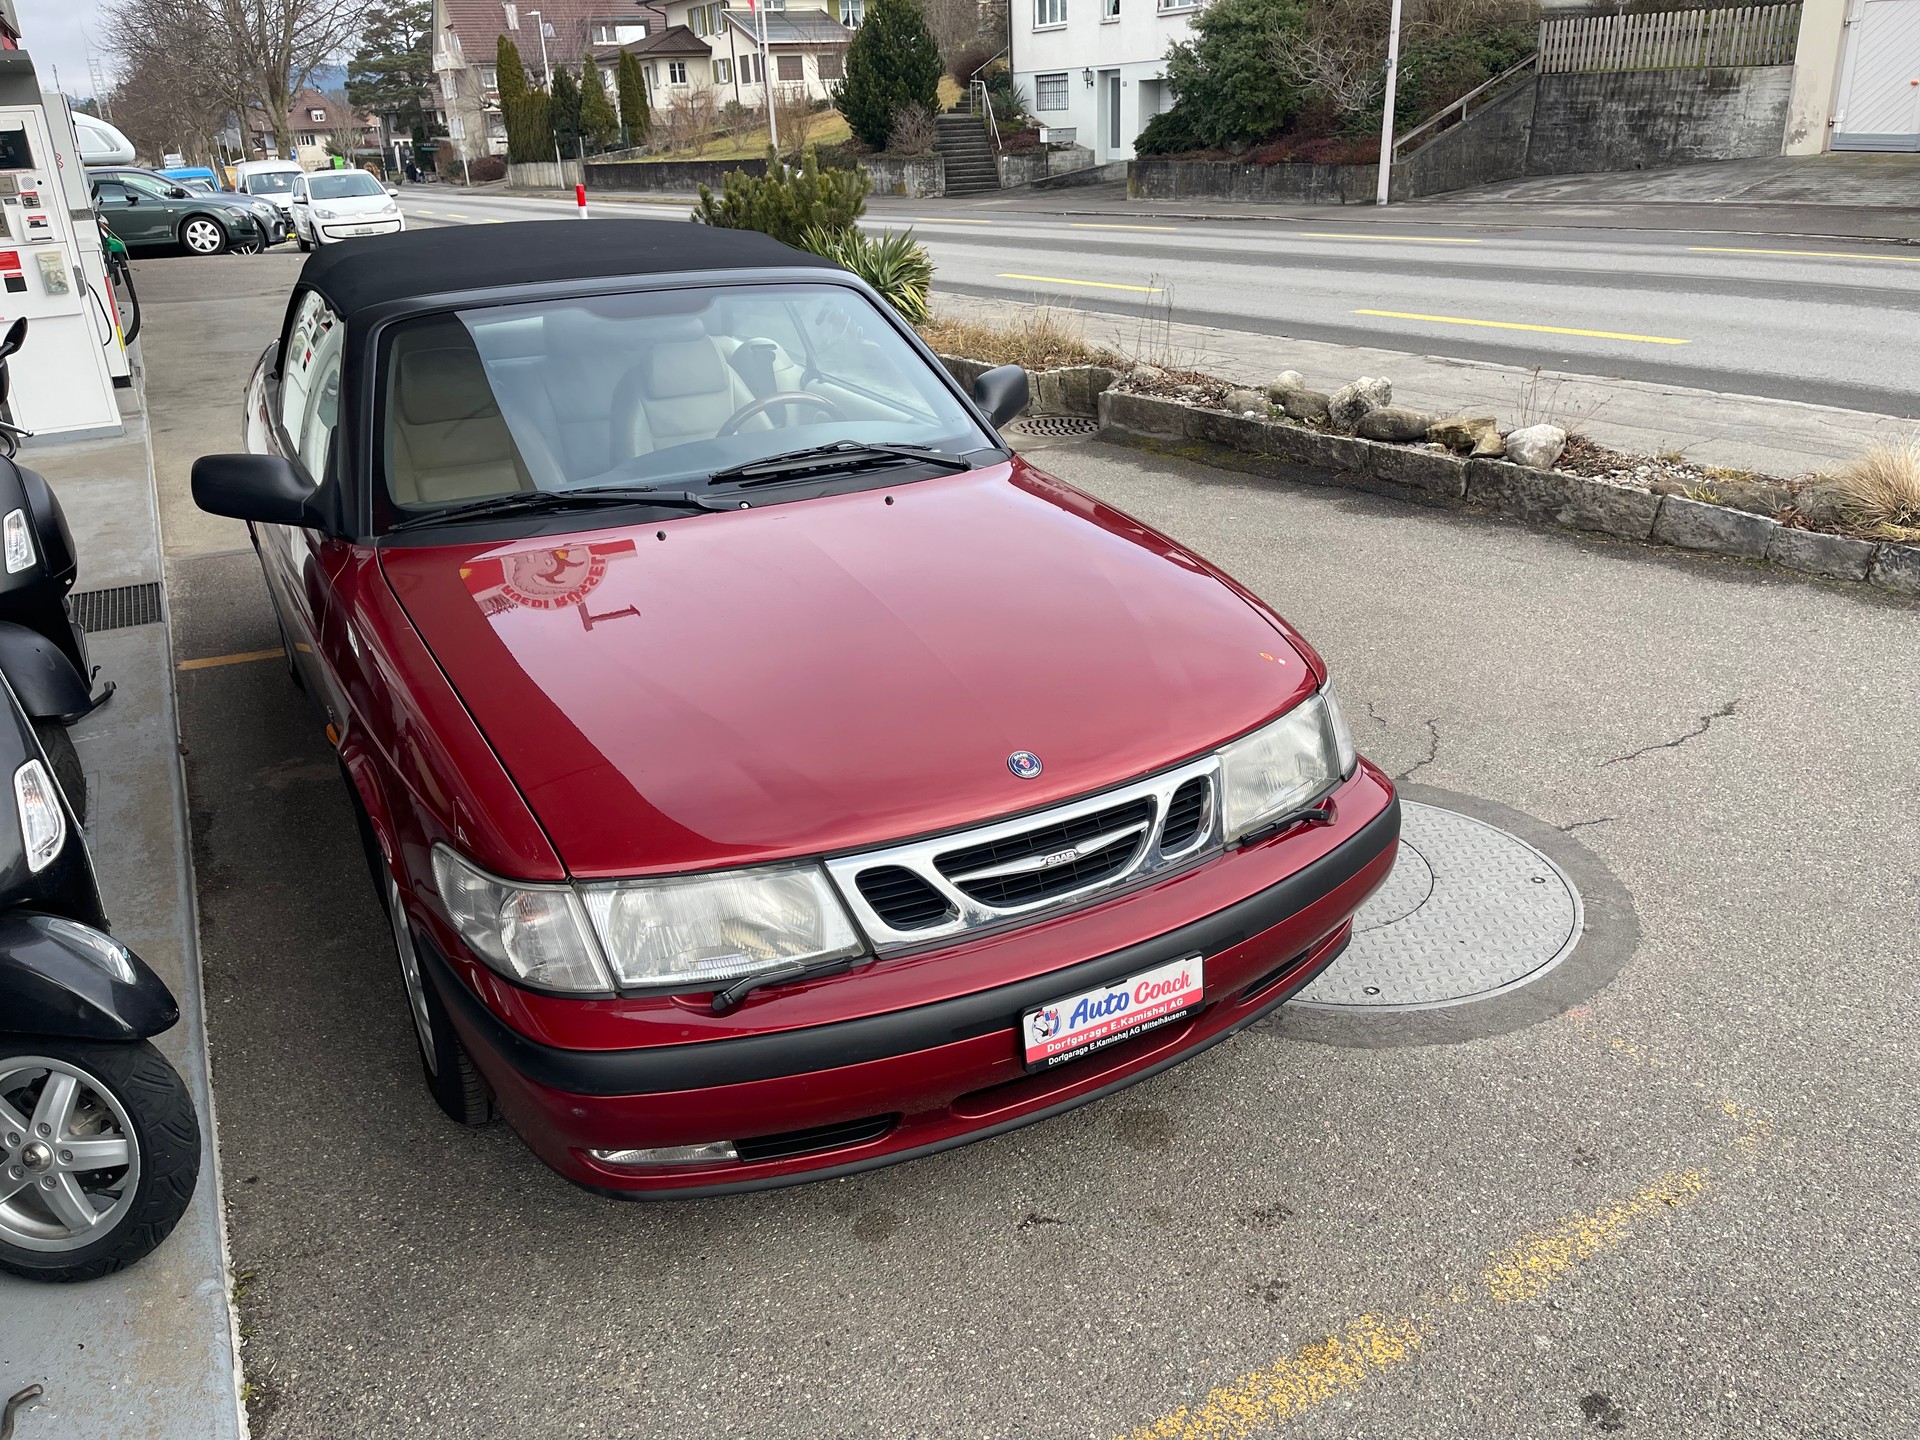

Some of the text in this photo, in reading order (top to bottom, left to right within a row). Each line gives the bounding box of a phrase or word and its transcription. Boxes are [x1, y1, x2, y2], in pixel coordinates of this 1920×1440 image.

[1047, 851, 1075, 865] SAAB
[1047, 998, 1183, 1052] Dorfgarage E.Kamishaj AG
[1069, 970, 1191, 1029] Auto Coach
[1048, 1010, 1187, 1065] Dorfgarage E.Kamishaj AG Mittelhäusern
